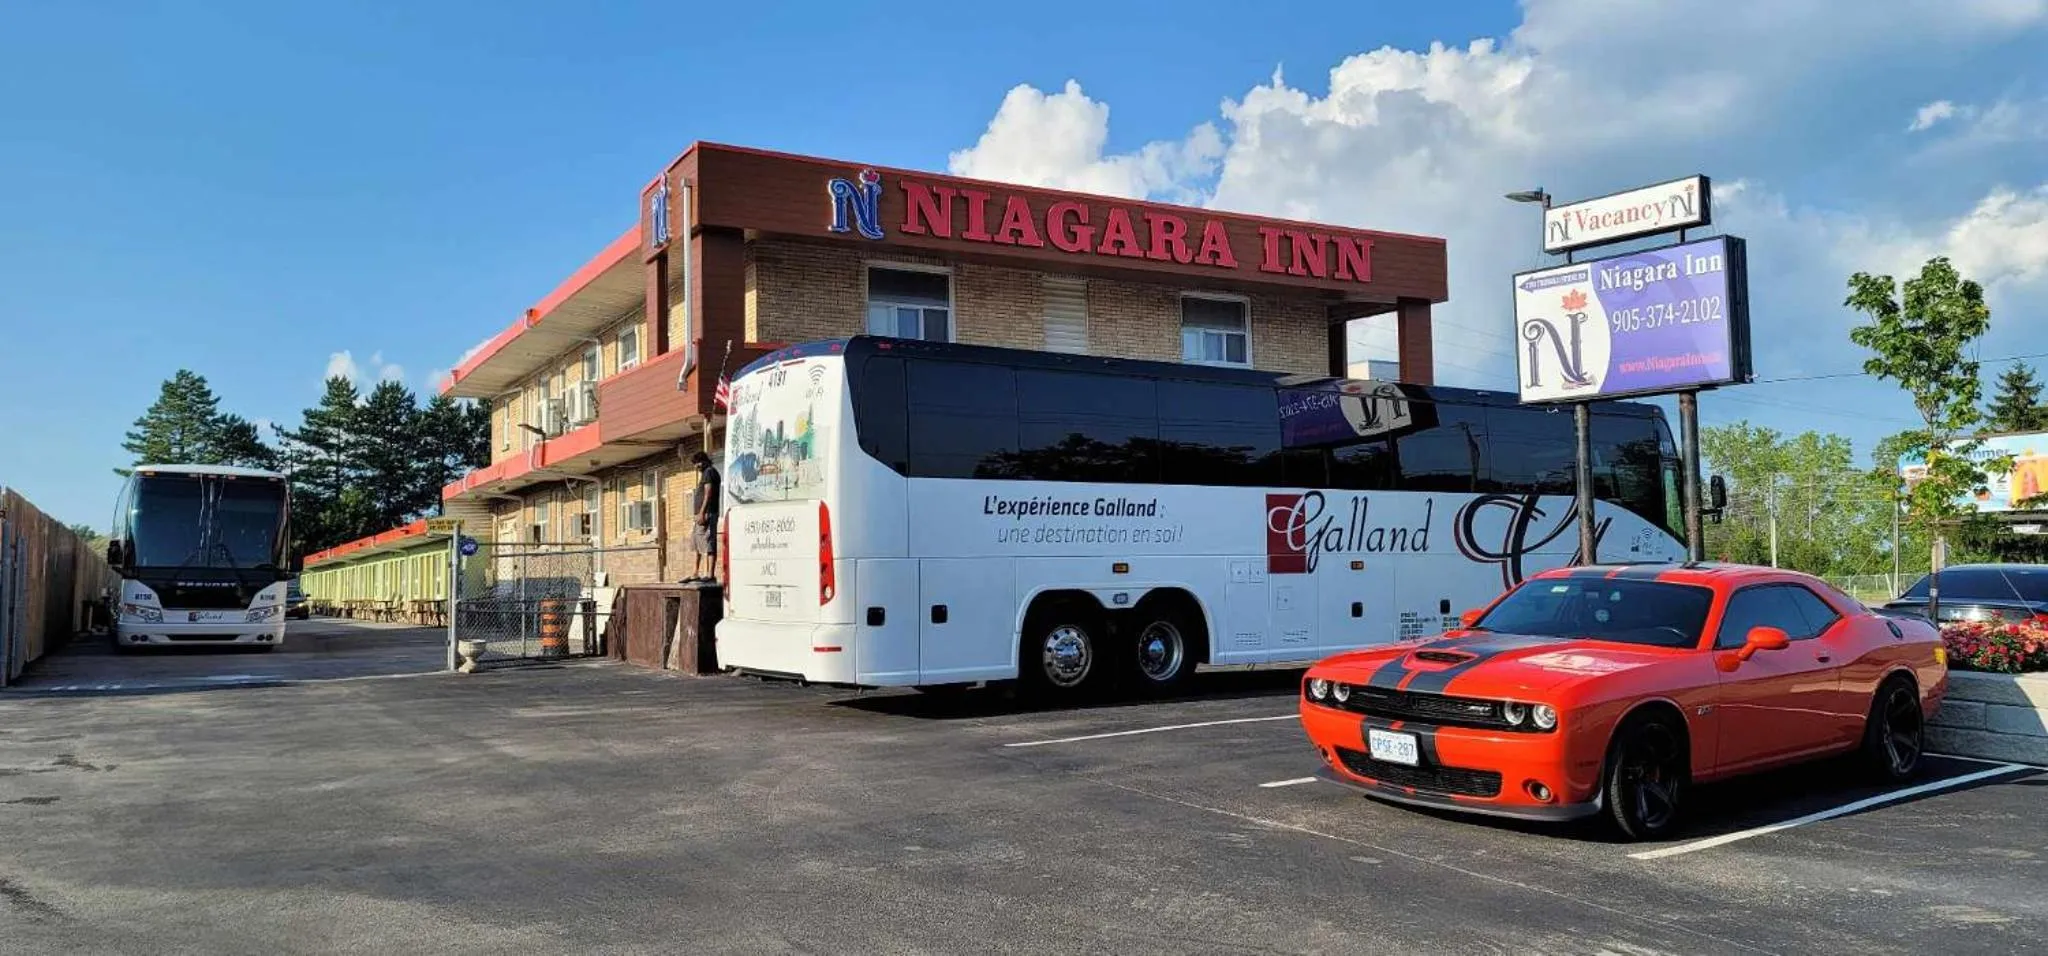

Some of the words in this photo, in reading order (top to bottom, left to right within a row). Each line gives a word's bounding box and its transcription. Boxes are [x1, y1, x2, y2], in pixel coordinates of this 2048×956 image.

[900, 180, 1239, 269] NIAGARA
[1258, 225, 1376, 283] INN
[1574, 201, 1669, 232] Vacancy
[1600, 260, 1677, 291] Niagara
[1685, 253, 1723, 279] Inn
[1612, 295, 1722, 333] 905-374-2102
[984, 496, 1090, 520] L'expérience
[1094, 498, 1157, 517] Galland
[999, 528, 1030, 544] une
[1035, 524, 1127, 544] destination
[1132, 528, 1150, 544] en
[1156, 525, 1183, 543] soi!
[1267, 490, 1433, 574] Galland
